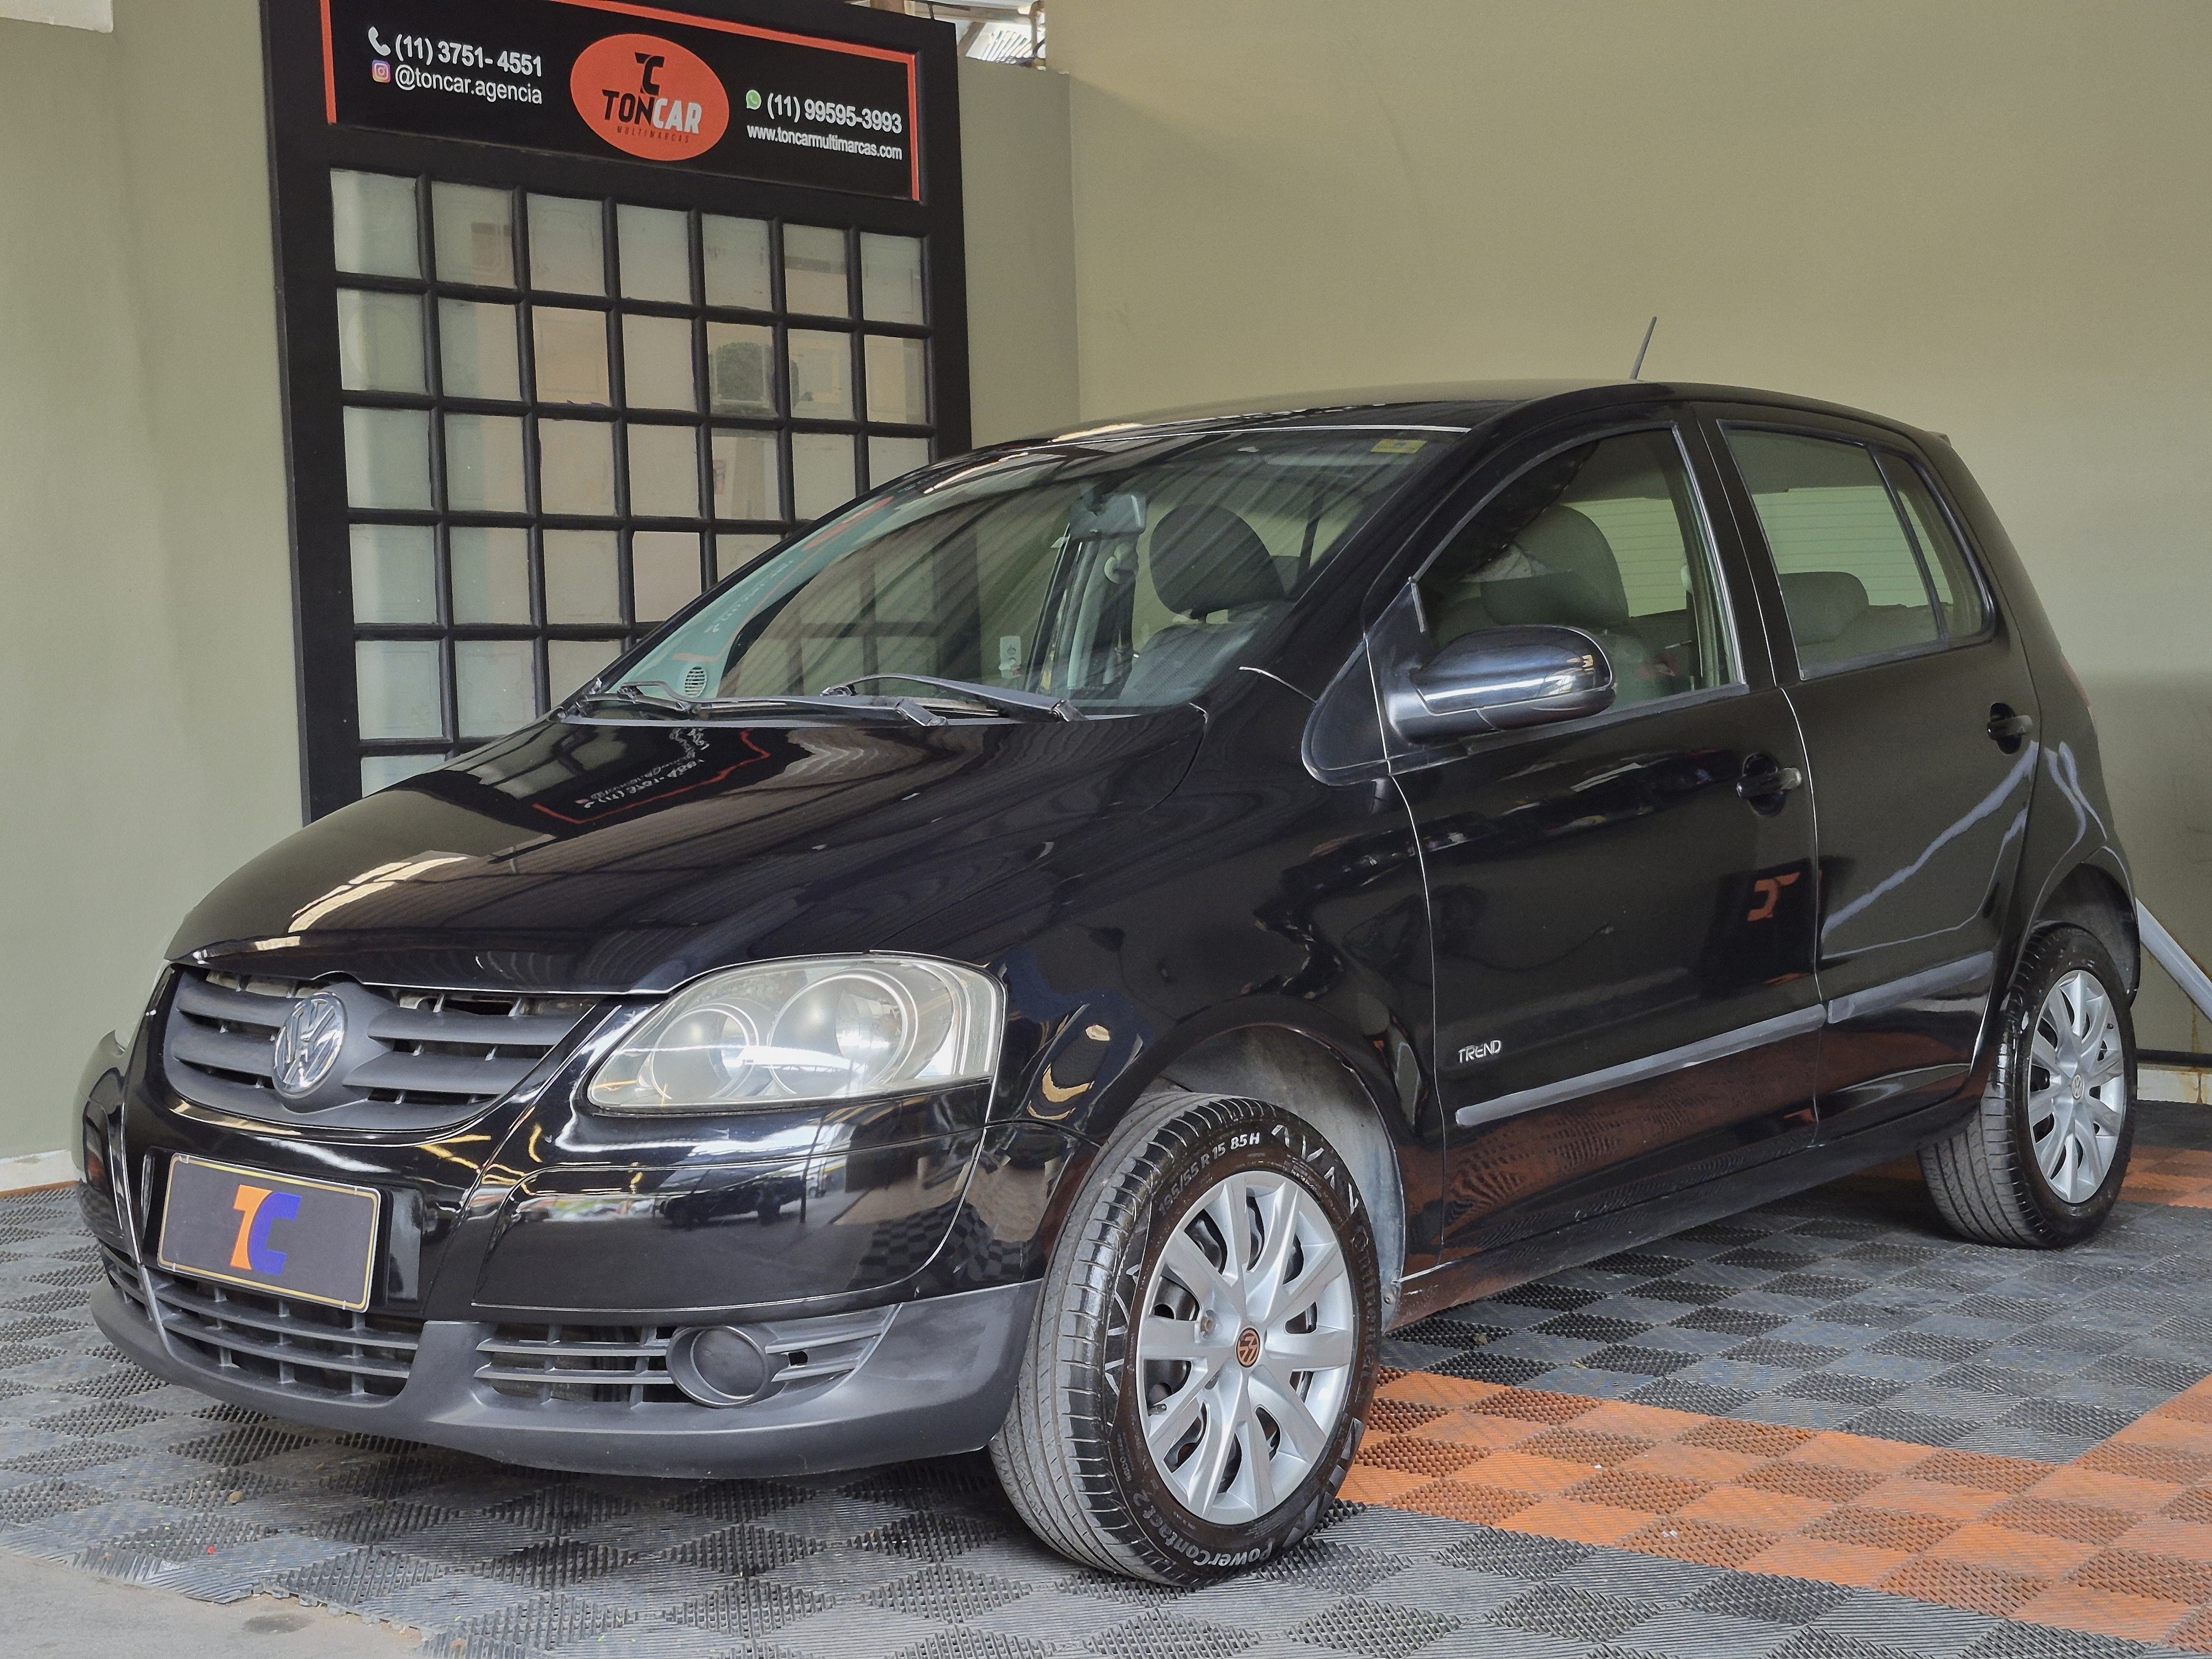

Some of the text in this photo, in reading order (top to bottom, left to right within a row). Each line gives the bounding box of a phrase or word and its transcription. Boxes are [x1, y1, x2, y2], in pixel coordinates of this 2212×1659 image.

[395, 33, 433, 65] (11)
[395, 64, 542, 104] @toncar.agencia
[602, 88, 702, 134] TONCAR
[767, 92, 902, 134] (11) 99595-3993
[747, 124, 903, 160] www.toncarmultimarcas.com
[1458, 1040, 1502, 1063] TREND
[1201, 1153, 1210, 1169] R
[1212, 1141, 1226, 1159] 15
[1142, 1505, 1274, 1566] PowerContact
